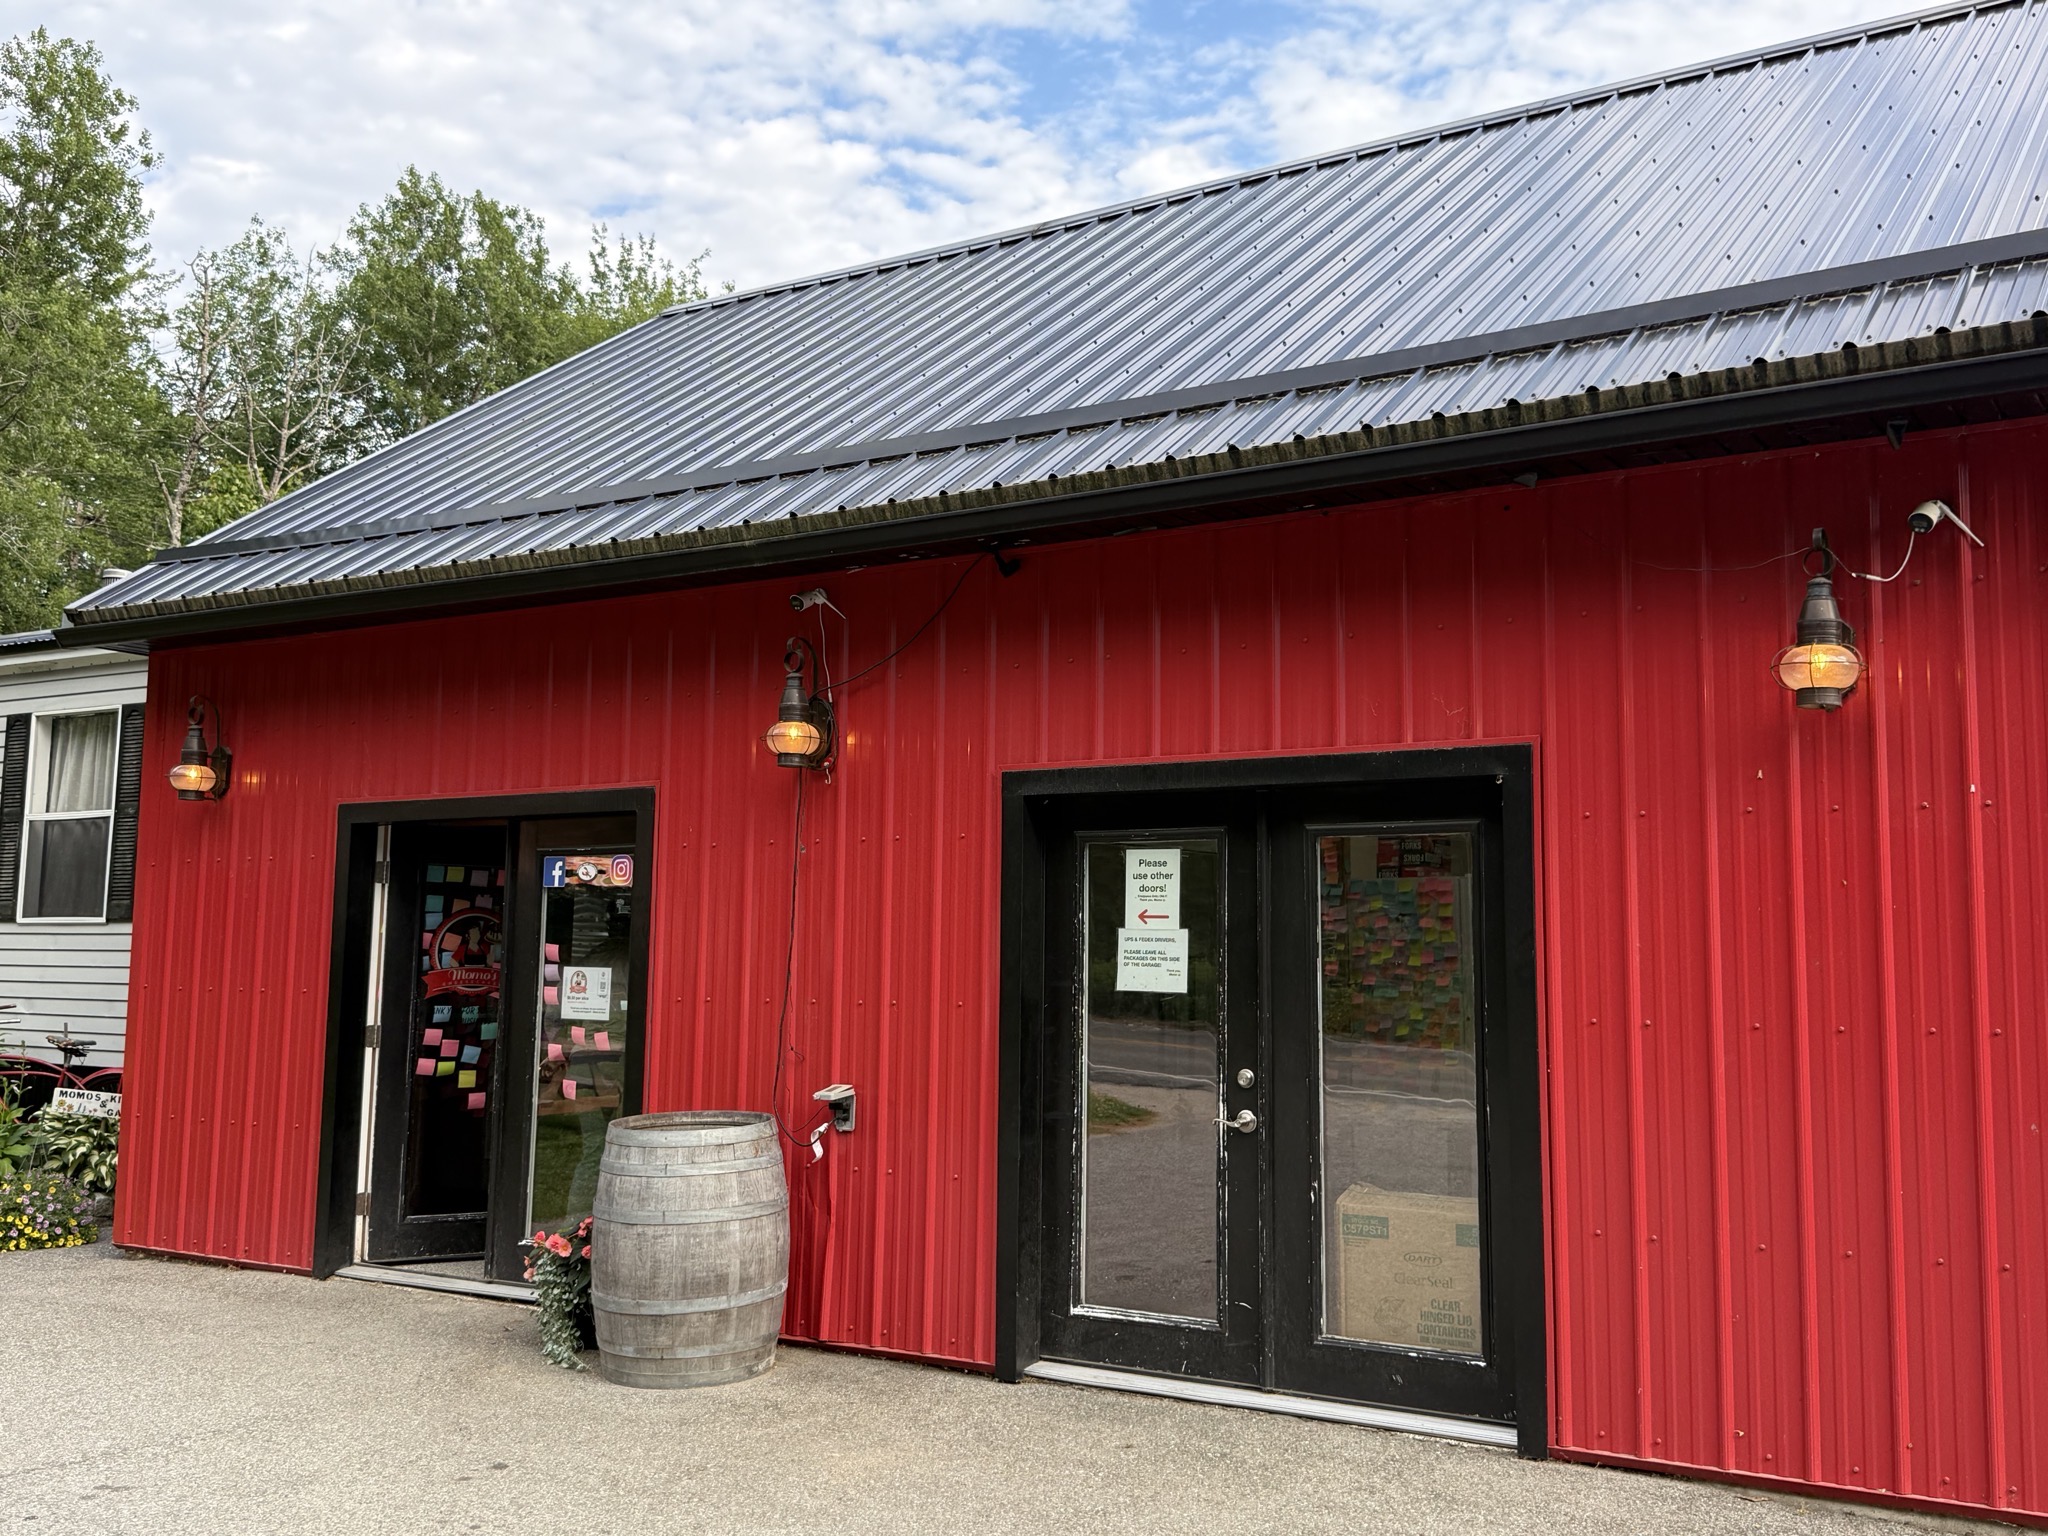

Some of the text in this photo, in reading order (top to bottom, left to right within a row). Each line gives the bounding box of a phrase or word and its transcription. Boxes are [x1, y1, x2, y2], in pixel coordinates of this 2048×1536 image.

[1401, 842, 1422, 850] FORKS
[1138, 858, 1168, 867] Please
[1403, 853, 1424, 862] FORKS
[1132, 871, 1174, 880] use other
[1138, 884, 1167, 892] doors!
[448, 969, 497, 981] Momo's
[58, 1090, 101, 1102] MOMOS
[99, 1100, 107, 1108] &
[1343, 1223, 1387, 1236] C57PST1
[1408, 1254, 1439, 1264] DART
[1431, 1298, 1461, 1312] CLEAR
[1420, 1310, 1472, 1327] HINGED LID
[1417, 1322, 1477, 1340] CONTAINERS
